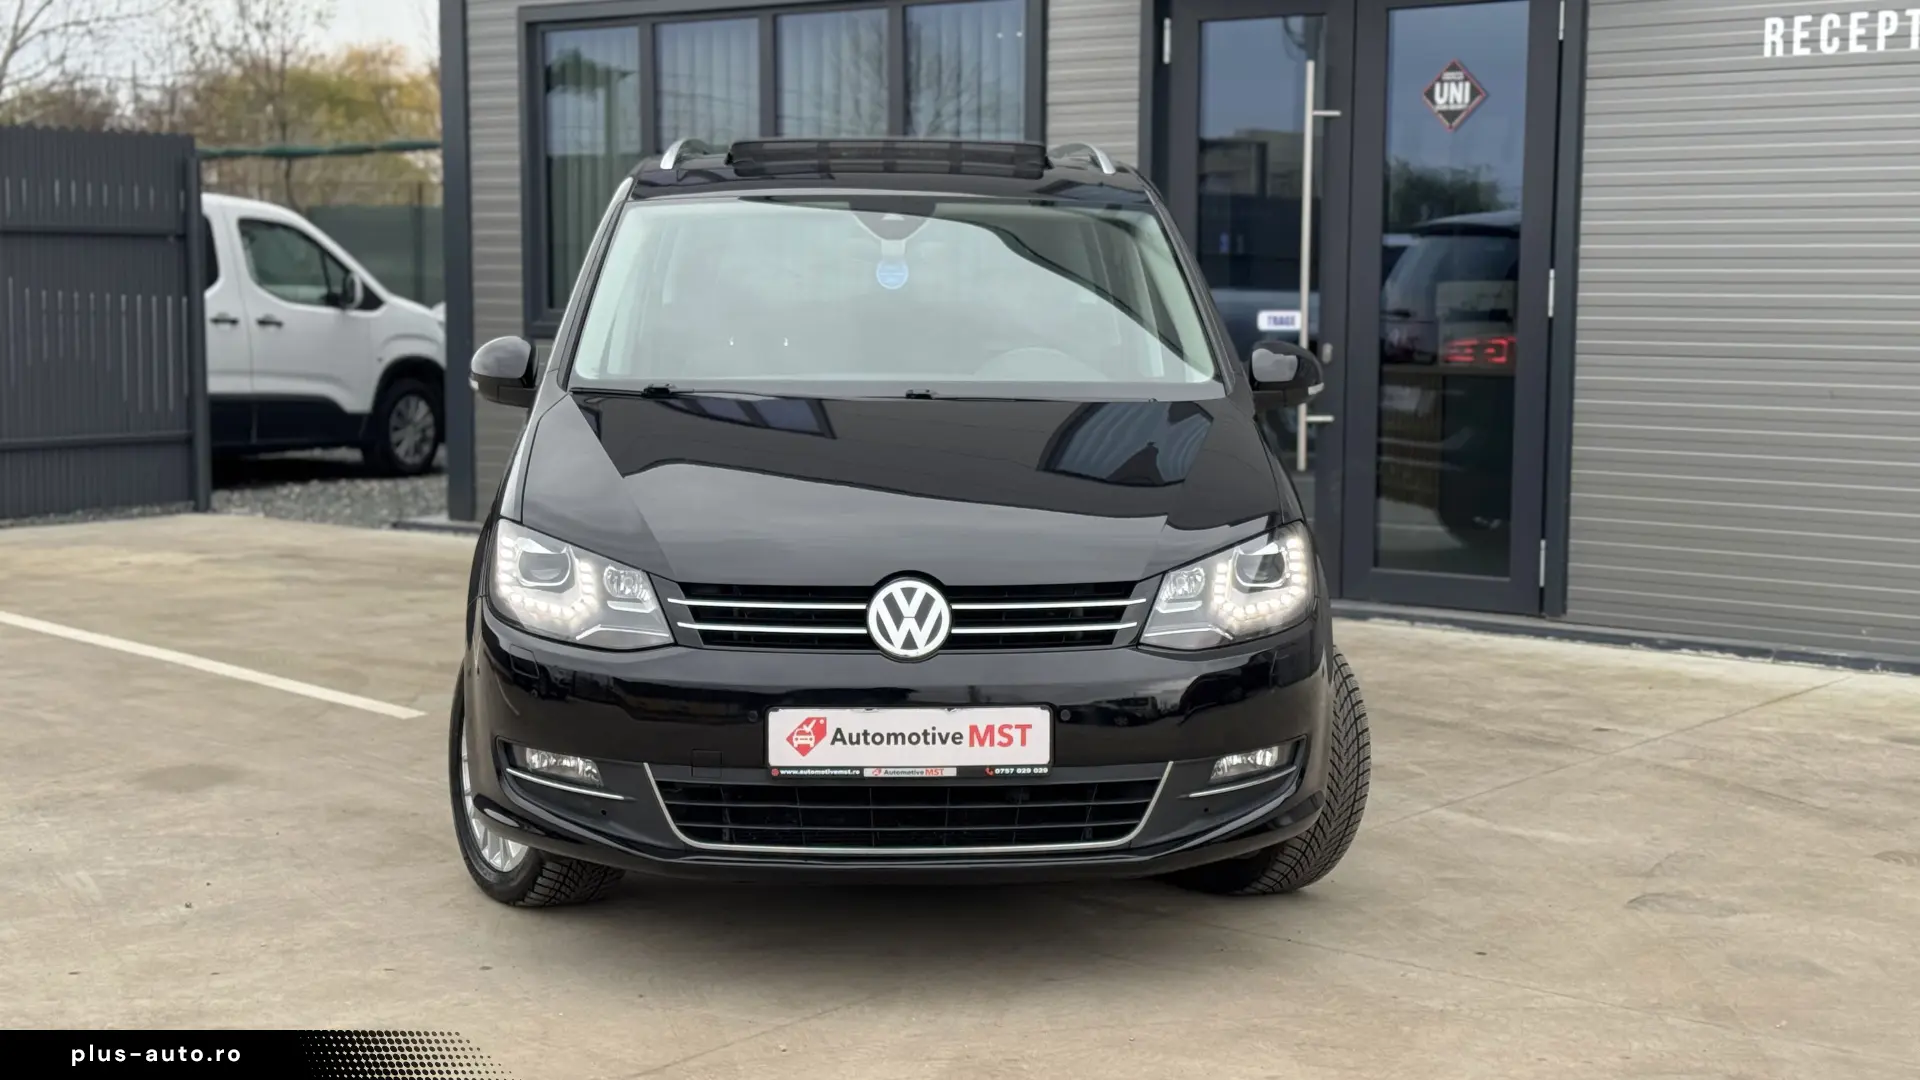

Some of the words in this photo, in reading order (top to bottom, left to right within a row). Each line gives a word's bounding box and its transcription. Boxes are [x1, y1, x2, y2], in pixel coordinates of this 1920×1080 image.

[1763, 8, 1920, 58] RECEPT
[1434, 81, 1471, 105] UNI
[868, 579, 950, 657] VW
[829, 726, 964, 747] Automotive
[968, 723, 1033, 748] MST
[779, 768, 861, 776] www.automotivemst.ro
[883, 769, 925, 777] Automotive
[925, 768, 945, 776] MST
